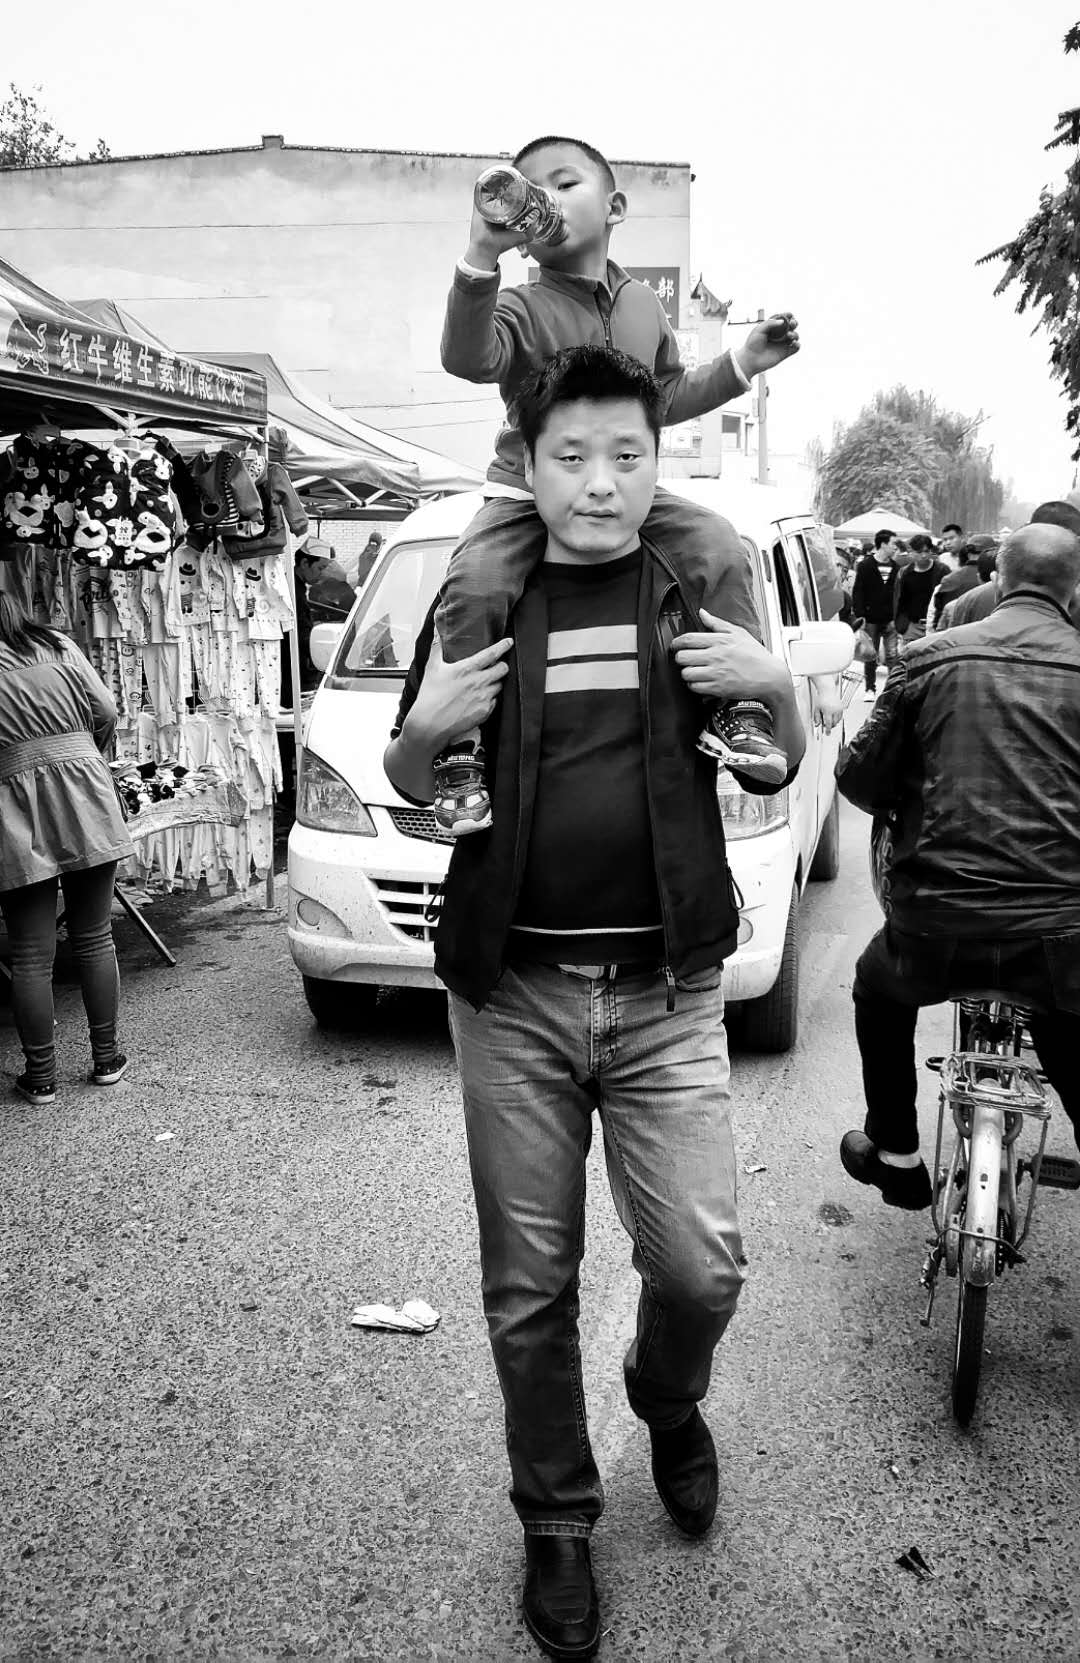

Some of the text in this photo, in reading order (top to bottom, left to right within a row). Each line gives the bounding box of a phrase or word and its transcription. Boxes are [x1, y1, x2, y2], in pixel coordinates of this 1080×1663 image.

[59, 328, 245, 406] 红牛维生素功能饮料
